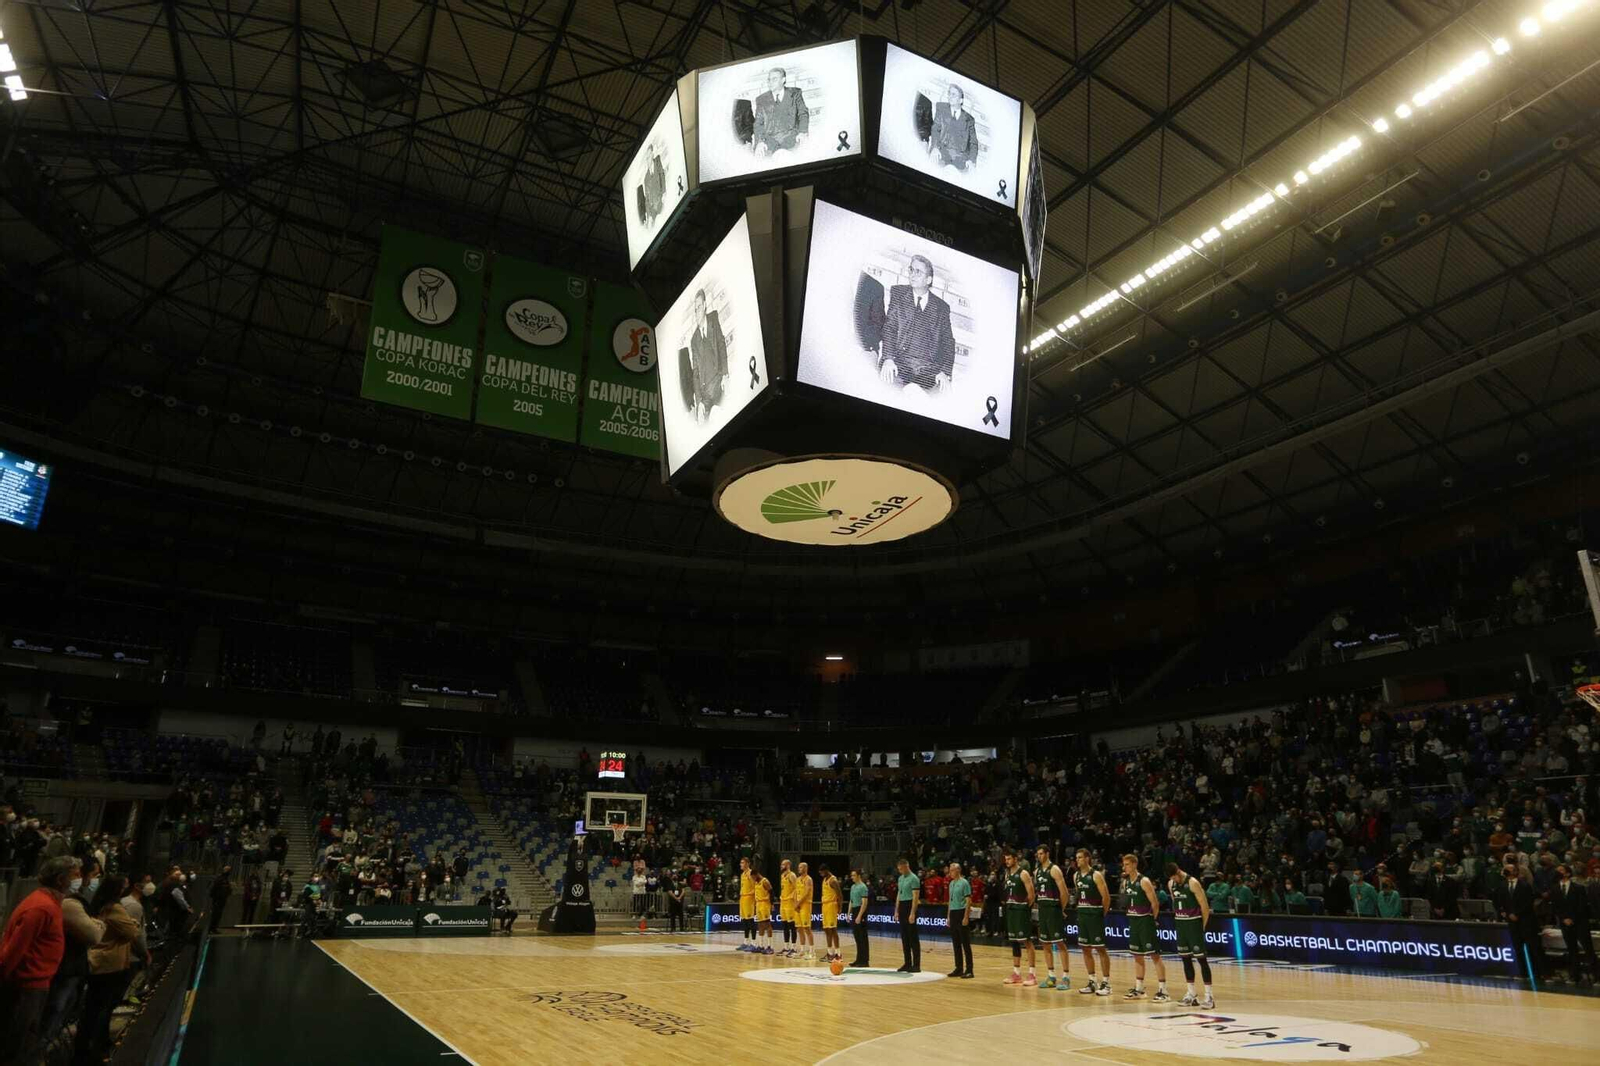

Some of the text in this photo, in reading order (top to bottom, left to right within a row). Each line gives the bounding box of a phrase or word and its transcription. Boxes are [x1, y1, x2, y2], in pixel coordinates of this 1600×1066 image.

[373, 326, 473, 369] CAMPEONES
[640, 334, 650, 366] ACB
[376, 349, 466, 380] COPA KORAC
[485, 354, 577, 393] CAMPEONES
[386, 370, 453, 396] 2000/2001
[482, 374, 577, 406] COPA DEL REY
[588, 379, 658, 411] CAMPEON
[513, 399, 544, 416] 2005
[611, 405, 650, 427] ACB
[600, 420, 659, 441] 2005/2006
[830, 495, 908, 535] Unicaja
[608, 760, 623, 771] 24
[1259, 934, 1515, 962] BASKETBALL CHAMPIONS LEAGUE
